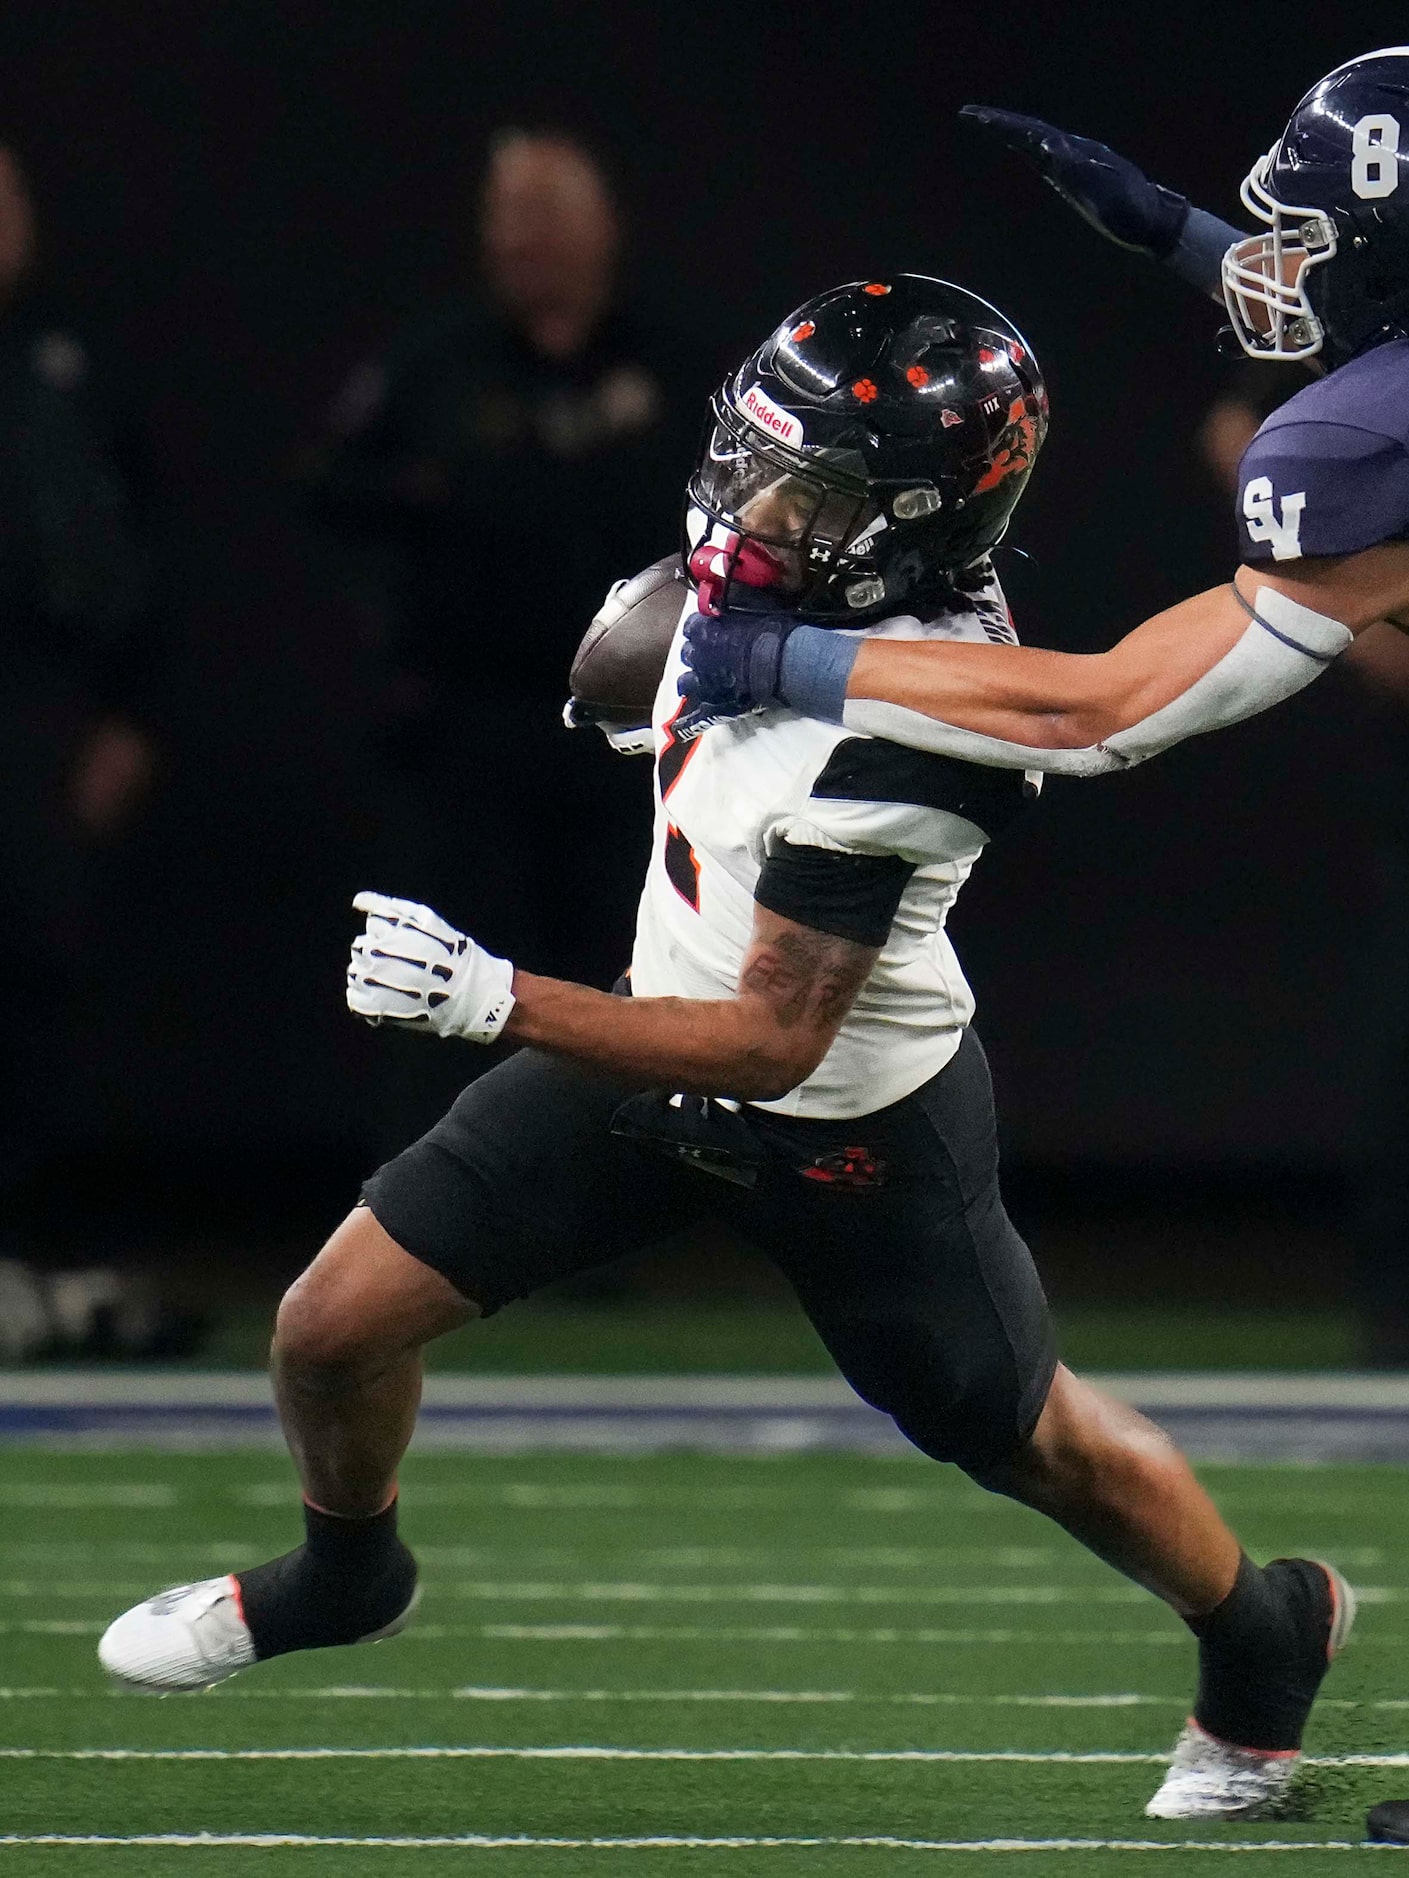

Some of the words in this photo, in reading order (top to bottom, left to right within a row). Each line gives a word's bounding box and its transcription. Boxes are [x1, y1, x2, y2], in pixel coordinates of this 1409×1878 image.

[1351, 114, 1400, 200] 8
[746, 391, 794, 439] Riddell
[1242, 475, 1307, 562] SV
